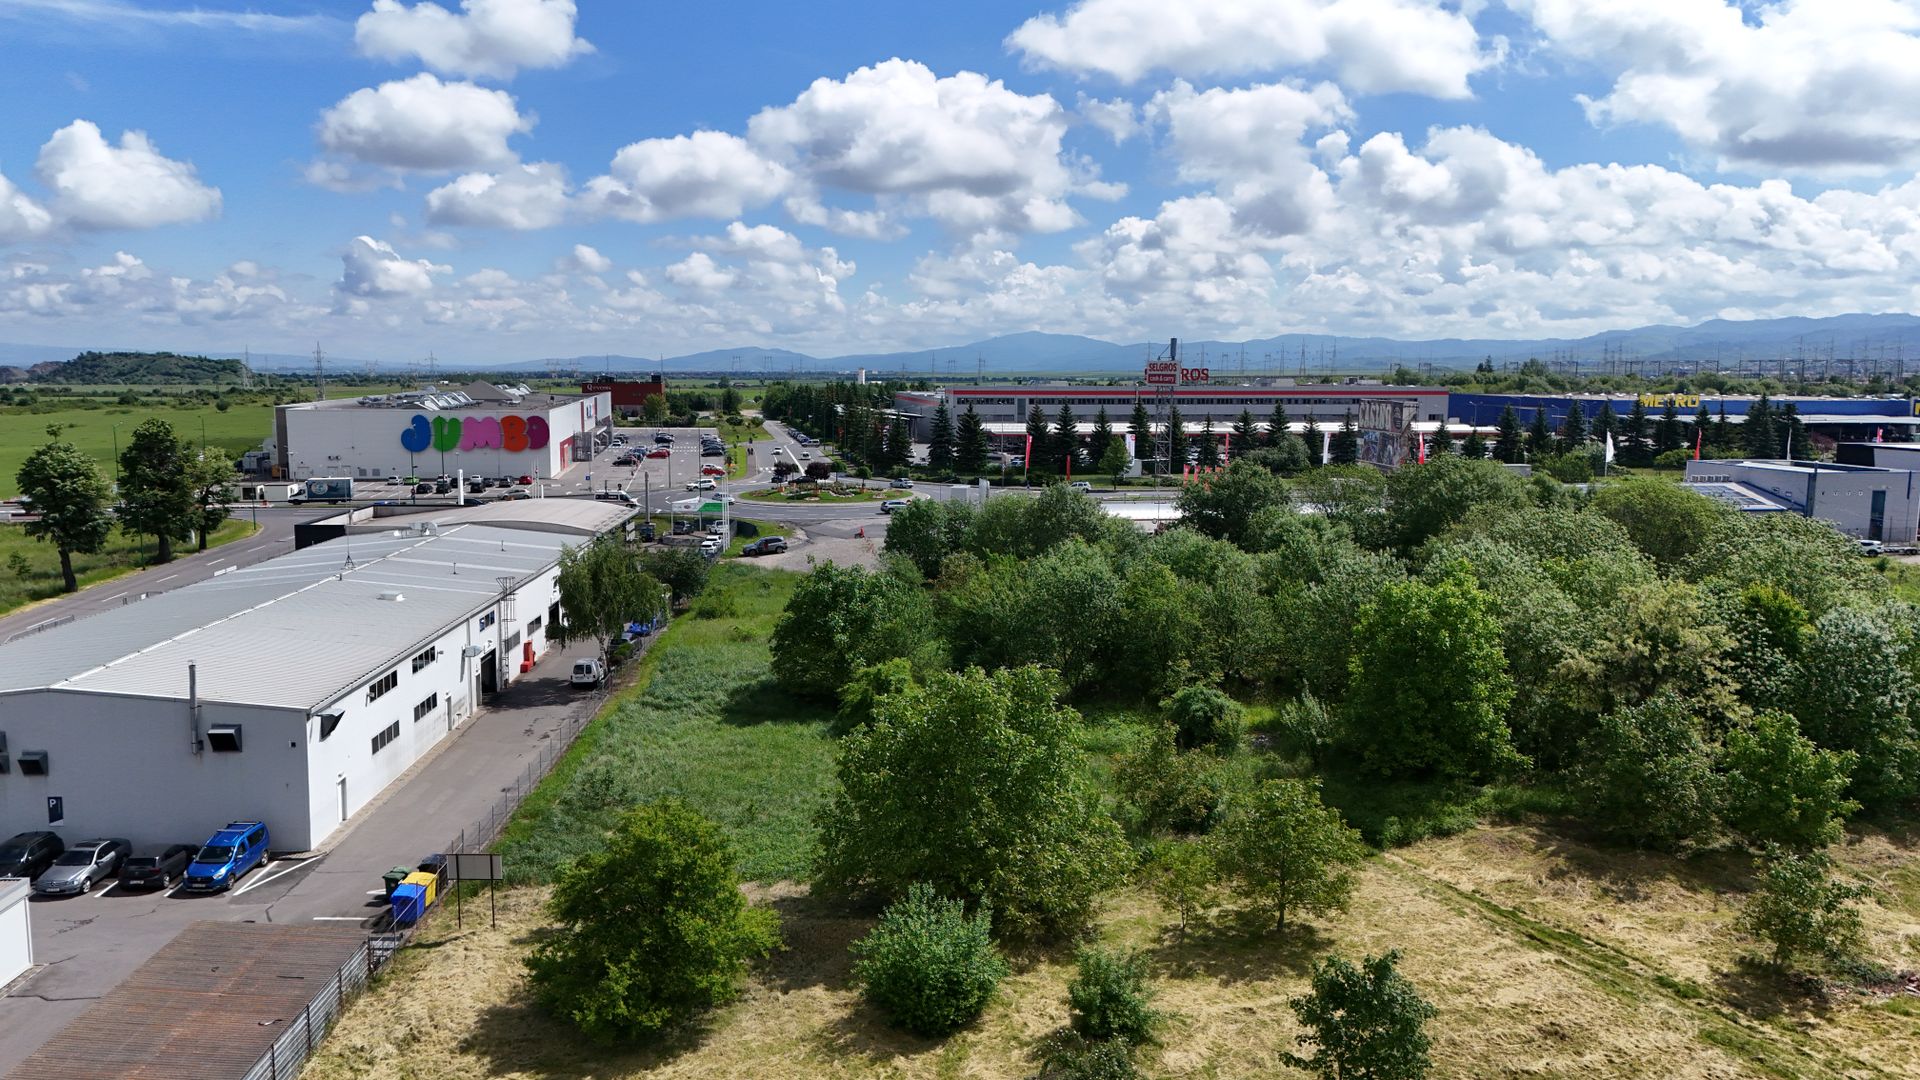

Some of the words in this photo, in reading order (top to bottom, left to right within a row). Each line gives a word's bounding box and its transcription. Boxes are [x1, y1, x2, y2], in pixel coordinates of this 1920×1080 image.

[1149, 363, 1177, 372] SELGROS
[1640, 394, 1699, 408] METRO
[401, 415, 549, 452] JUMBO
[50, 799, 56, 808] P
